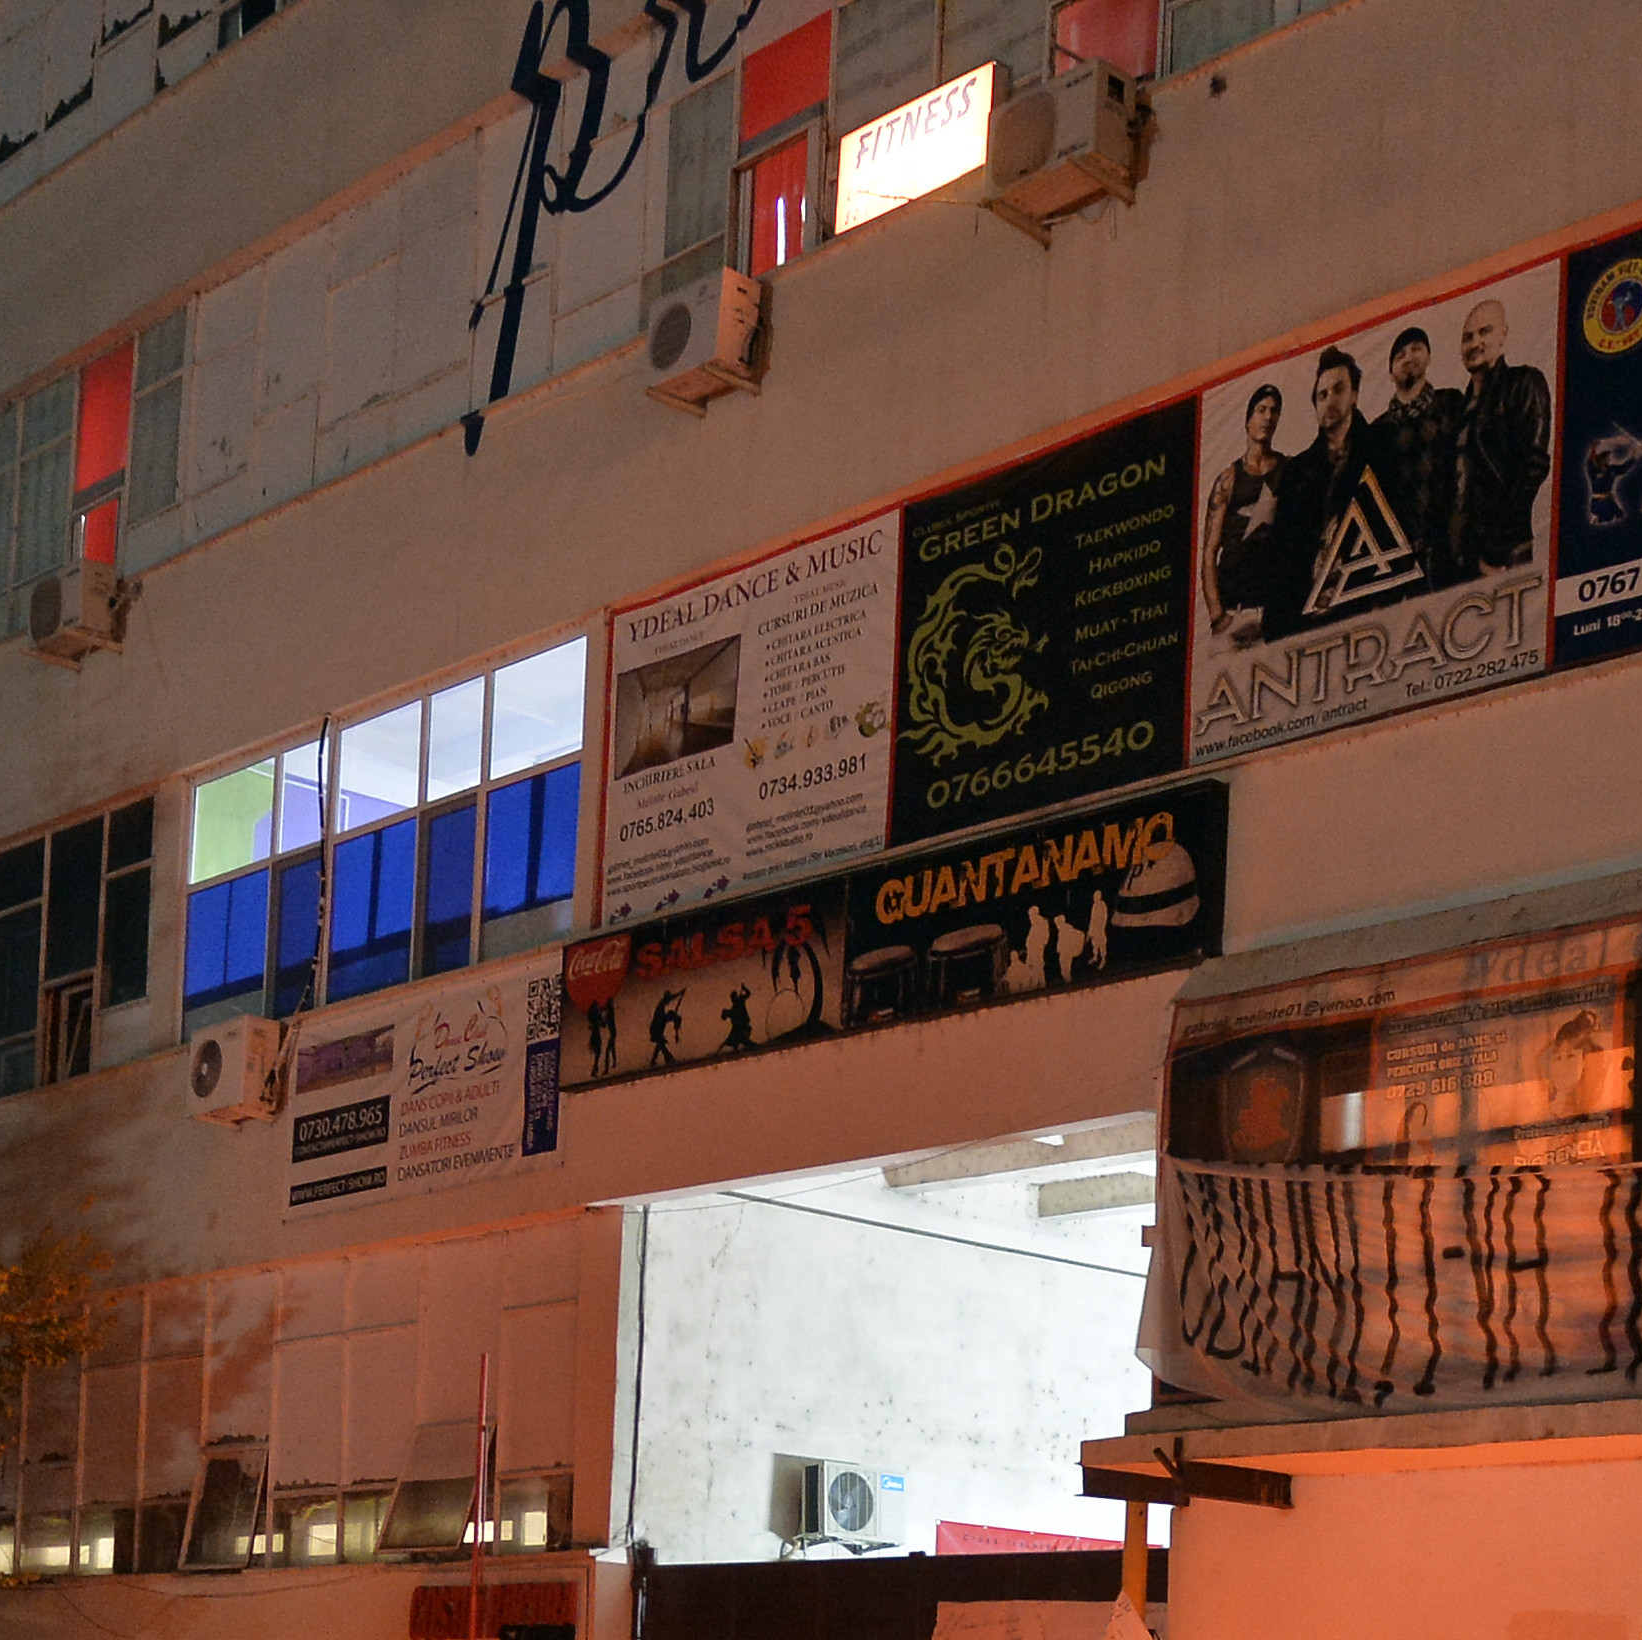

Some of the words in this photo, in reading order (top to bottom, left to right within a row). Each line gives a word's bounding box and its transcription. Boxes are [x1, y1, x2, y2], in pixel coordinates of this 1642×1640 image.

[856, 77, 977, 169] FITNESS
[919, 507, 1021, 563] GREEN
[1030, 454, 1167, 523] DRAGON
[1074, 504, 1175, 549] TAEKWONDO
[1089, 540, 1161, 575] HAPKIDO
[629, 602, 700, 642] YDEAL
[703, 568, 780, 618] DANCE
[785, 561, 800, 586] &
[806, 529, 884, 578] MUSIC
[1074, 565, 1172, 608] KICKBOXING
[1578, 565, 1641, 602] 0767
[758, 606, 808, 636] CURSURI
[809, 599, 826, 616] DE
[829, 582, 879, 610] MUZICA
[1573, 617, 1601, 636] Luni
[1069, 632, 1179, 675] TAI-CHI-CHUAN
[1195, 574, 1543, 737] ANTRACT
[1434, 650, 1540, 690] 0722.282.475
[1090, 671, 1153, 700] QIGONG
[1195, 698, 1368, 757] www.facebook.com/antract
[686, 756, 716, 776] SALA
[759, 753, 868, 801] 0734.933.981
[927, 720, 1155, 809] 0766645540
[619, 797, 715, 843] 0765.824.403
[876, 811, 1175, 926] GUANTANAMO
[634, 913, 778, 980] SALSA
[1387, 1041, 1438, 1061] CURSURI
[299, 1105, 383, 1143] 0730.478.965
[434, 1131, 472, 1152] FITNESS
